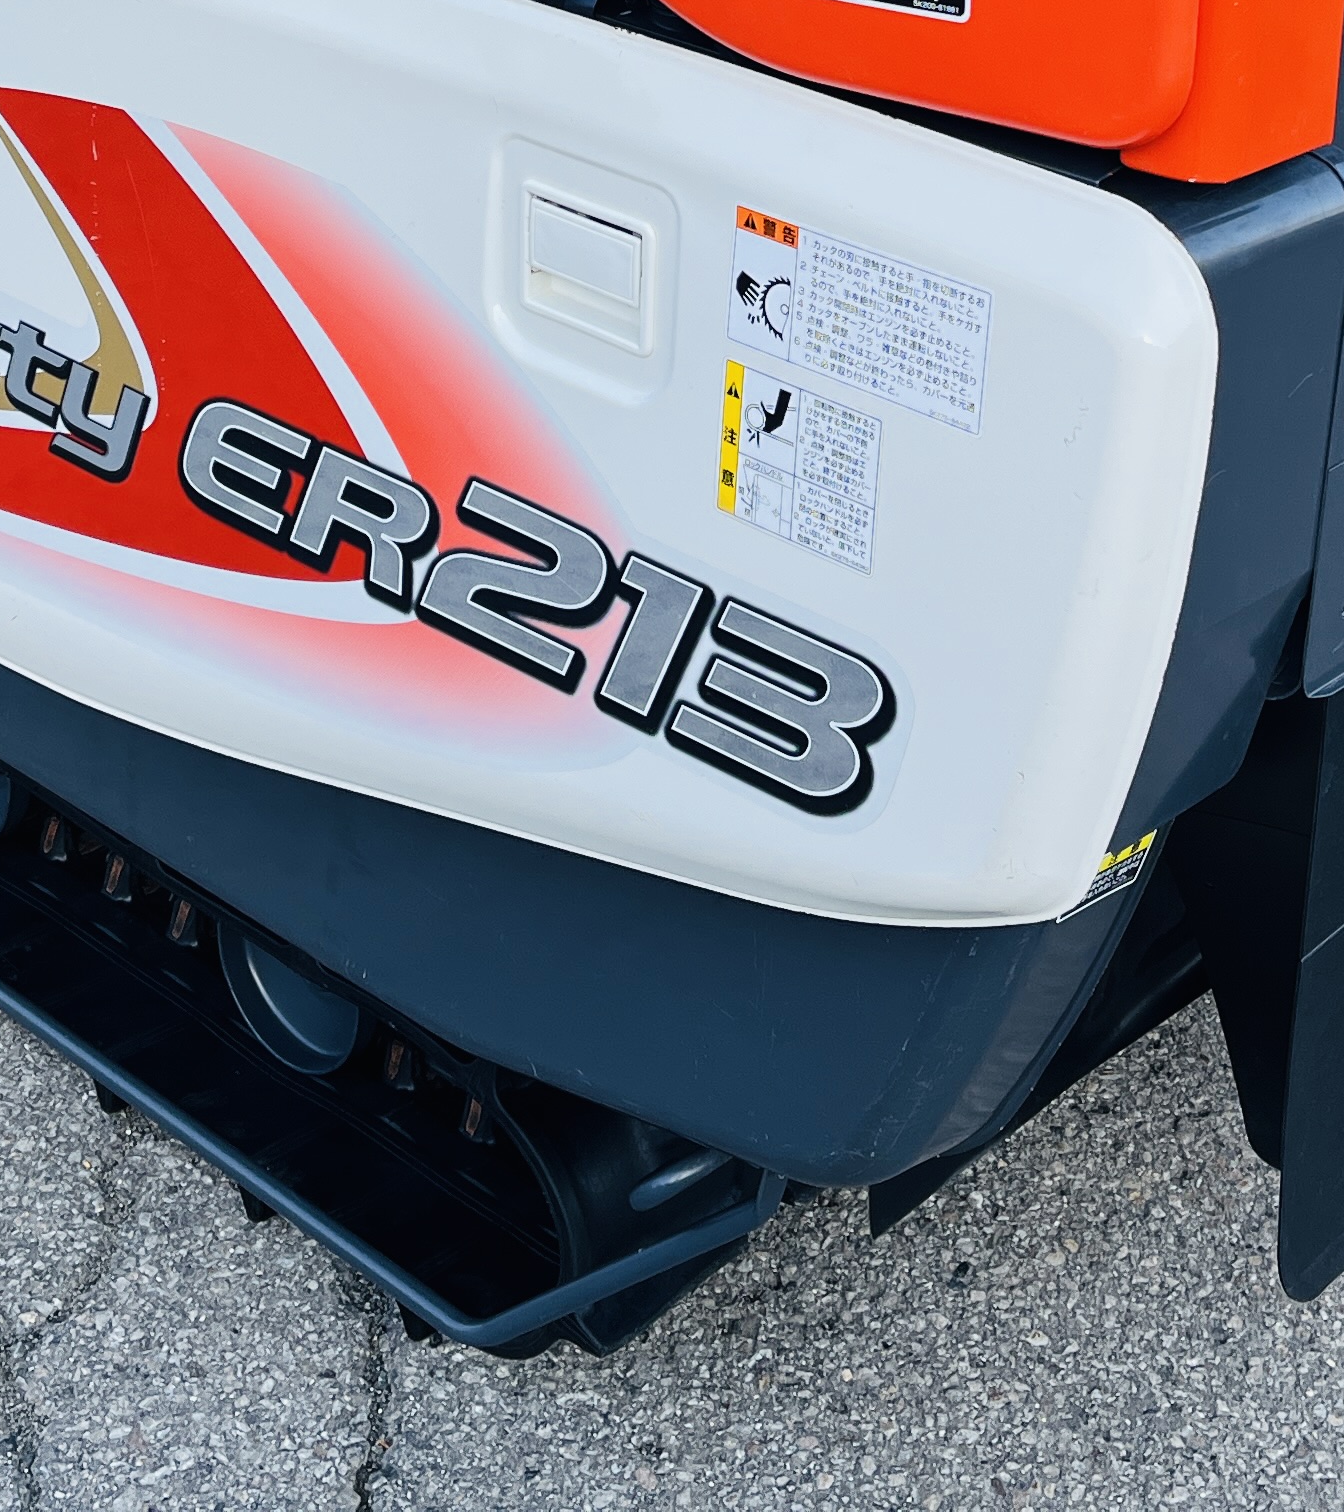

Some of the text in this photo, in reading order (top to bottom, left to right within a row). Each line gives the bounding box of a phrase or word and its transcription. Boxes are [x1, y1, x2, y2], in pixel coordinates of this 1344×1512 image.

[763, 217, 796, 245] 警告
[722, 426, 737, 488] 注意
[179, 396, 897, 818] ER213
